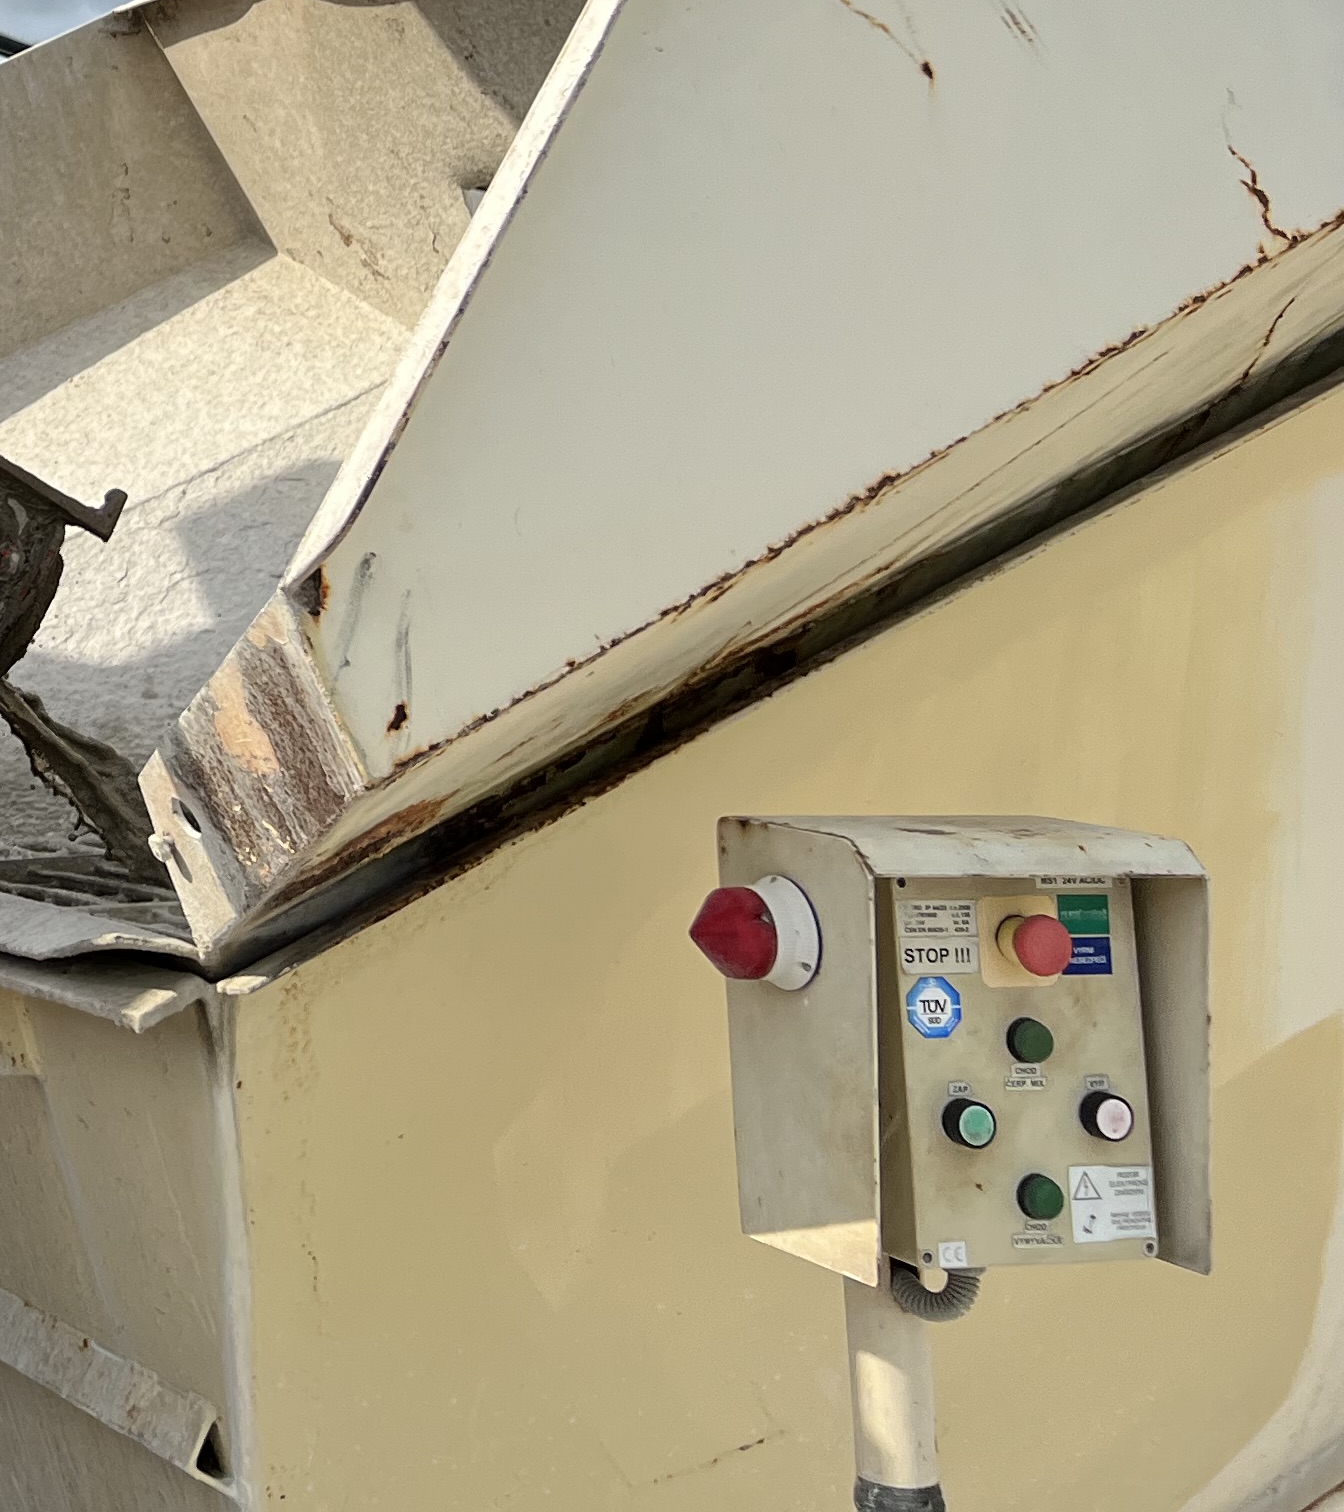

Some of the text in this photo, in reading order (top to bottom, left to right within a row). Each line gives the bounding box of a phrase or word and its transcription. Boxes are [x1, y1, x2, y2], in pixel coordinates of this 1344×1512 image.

[904, 948, 971, 963] STOP !!!
[919, 999, 947, 1013] TÜV
